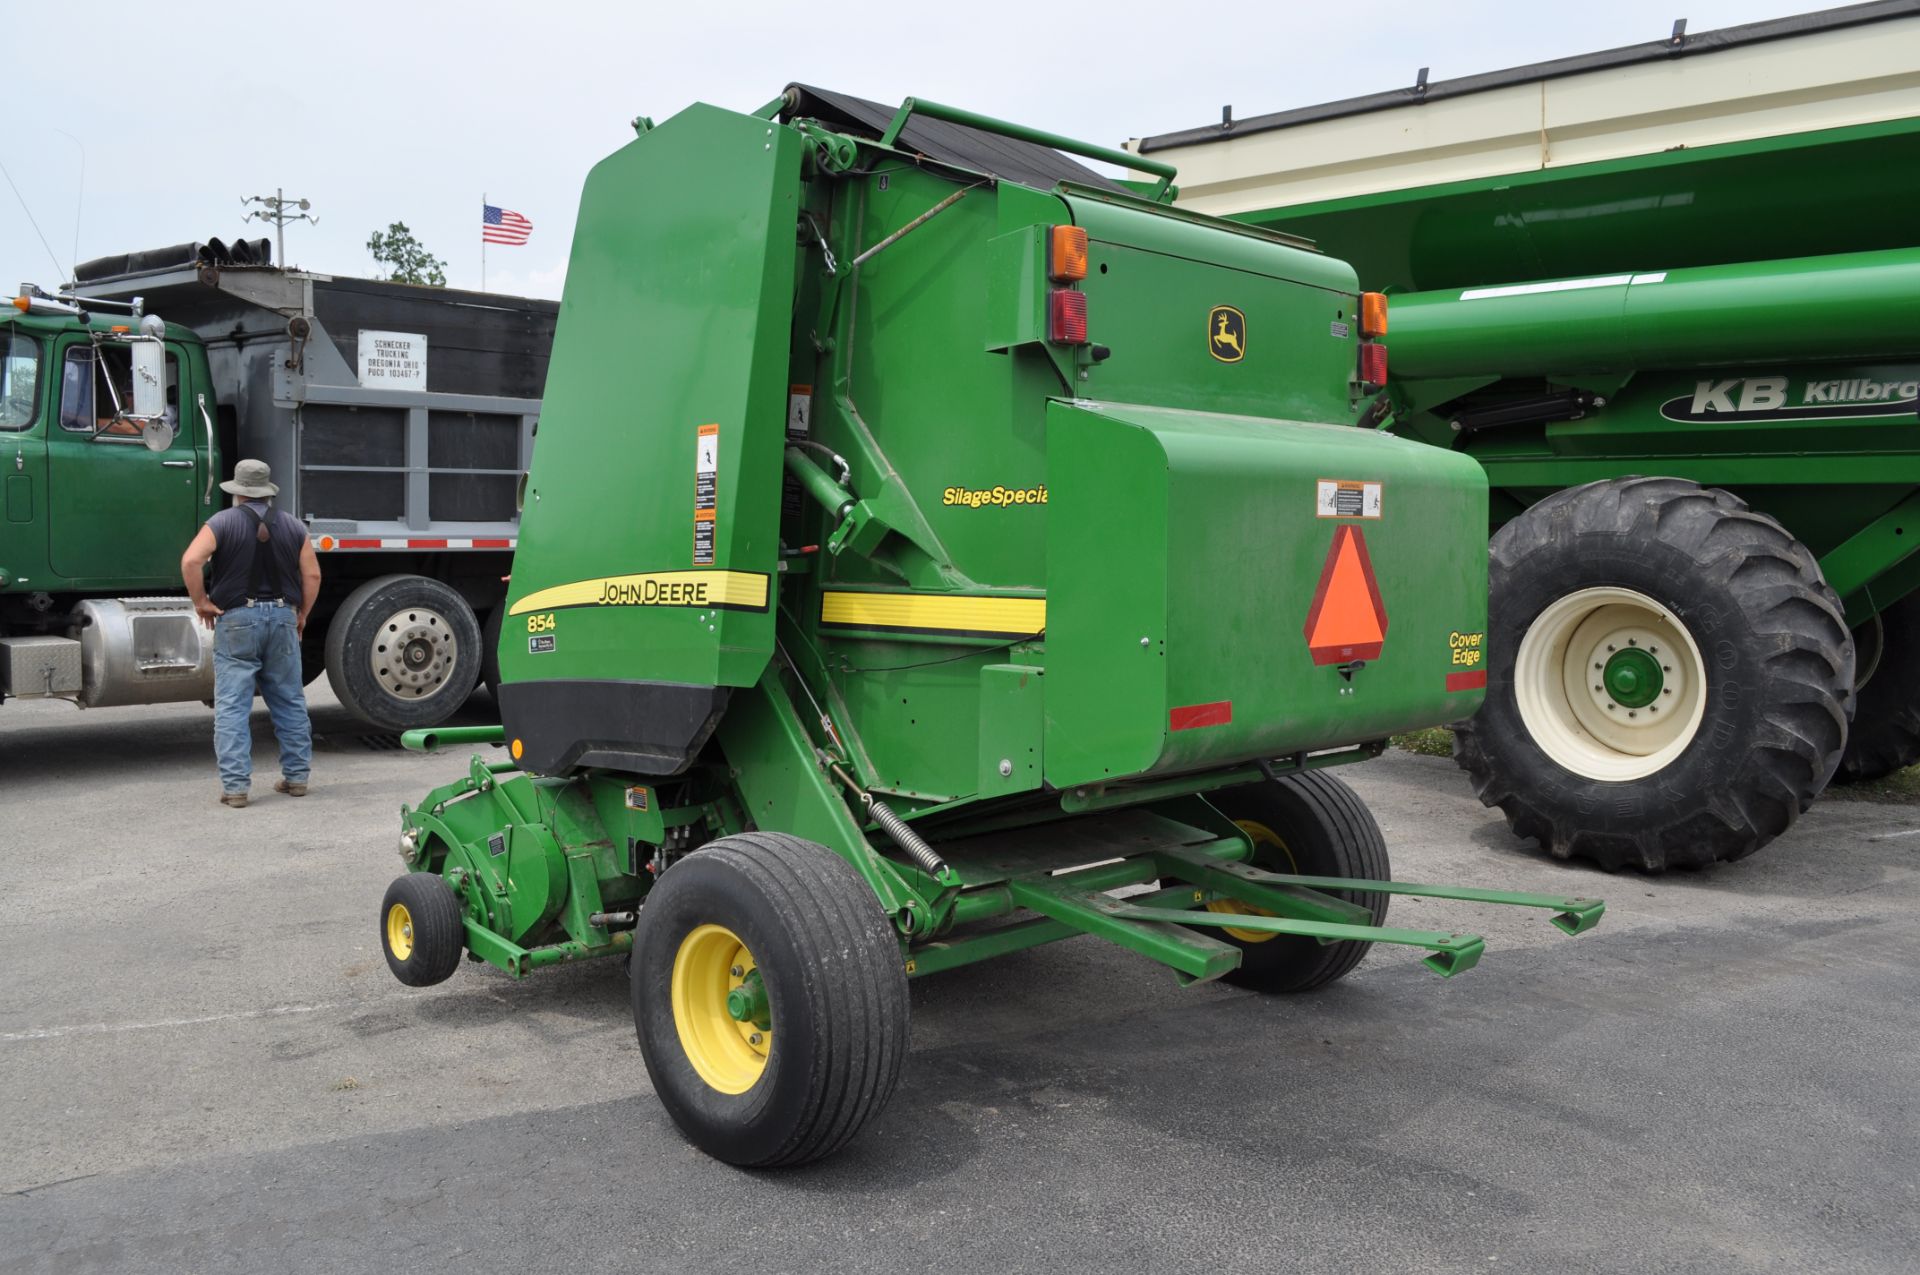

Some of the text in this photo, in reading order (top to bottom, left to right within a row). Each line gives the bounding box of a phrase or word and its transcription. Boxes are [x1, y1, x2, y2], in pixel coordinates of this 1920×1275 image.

[375, 340, 410, 349] SCHNECKER
[377, 350, 408, 359] TRUCKING
[368, 359, 418, 369] OREGONIA OHIO
[368, 368, 385, 376] PUCO
[1690, 376, 1789, 414] KB
[599, 579, 708, 602] JOHN DEERE
[527, 613, 556, 632] 854
[1449, 631, 1483, 648] Cover
[1452, 648, 1481, 666] Edge
